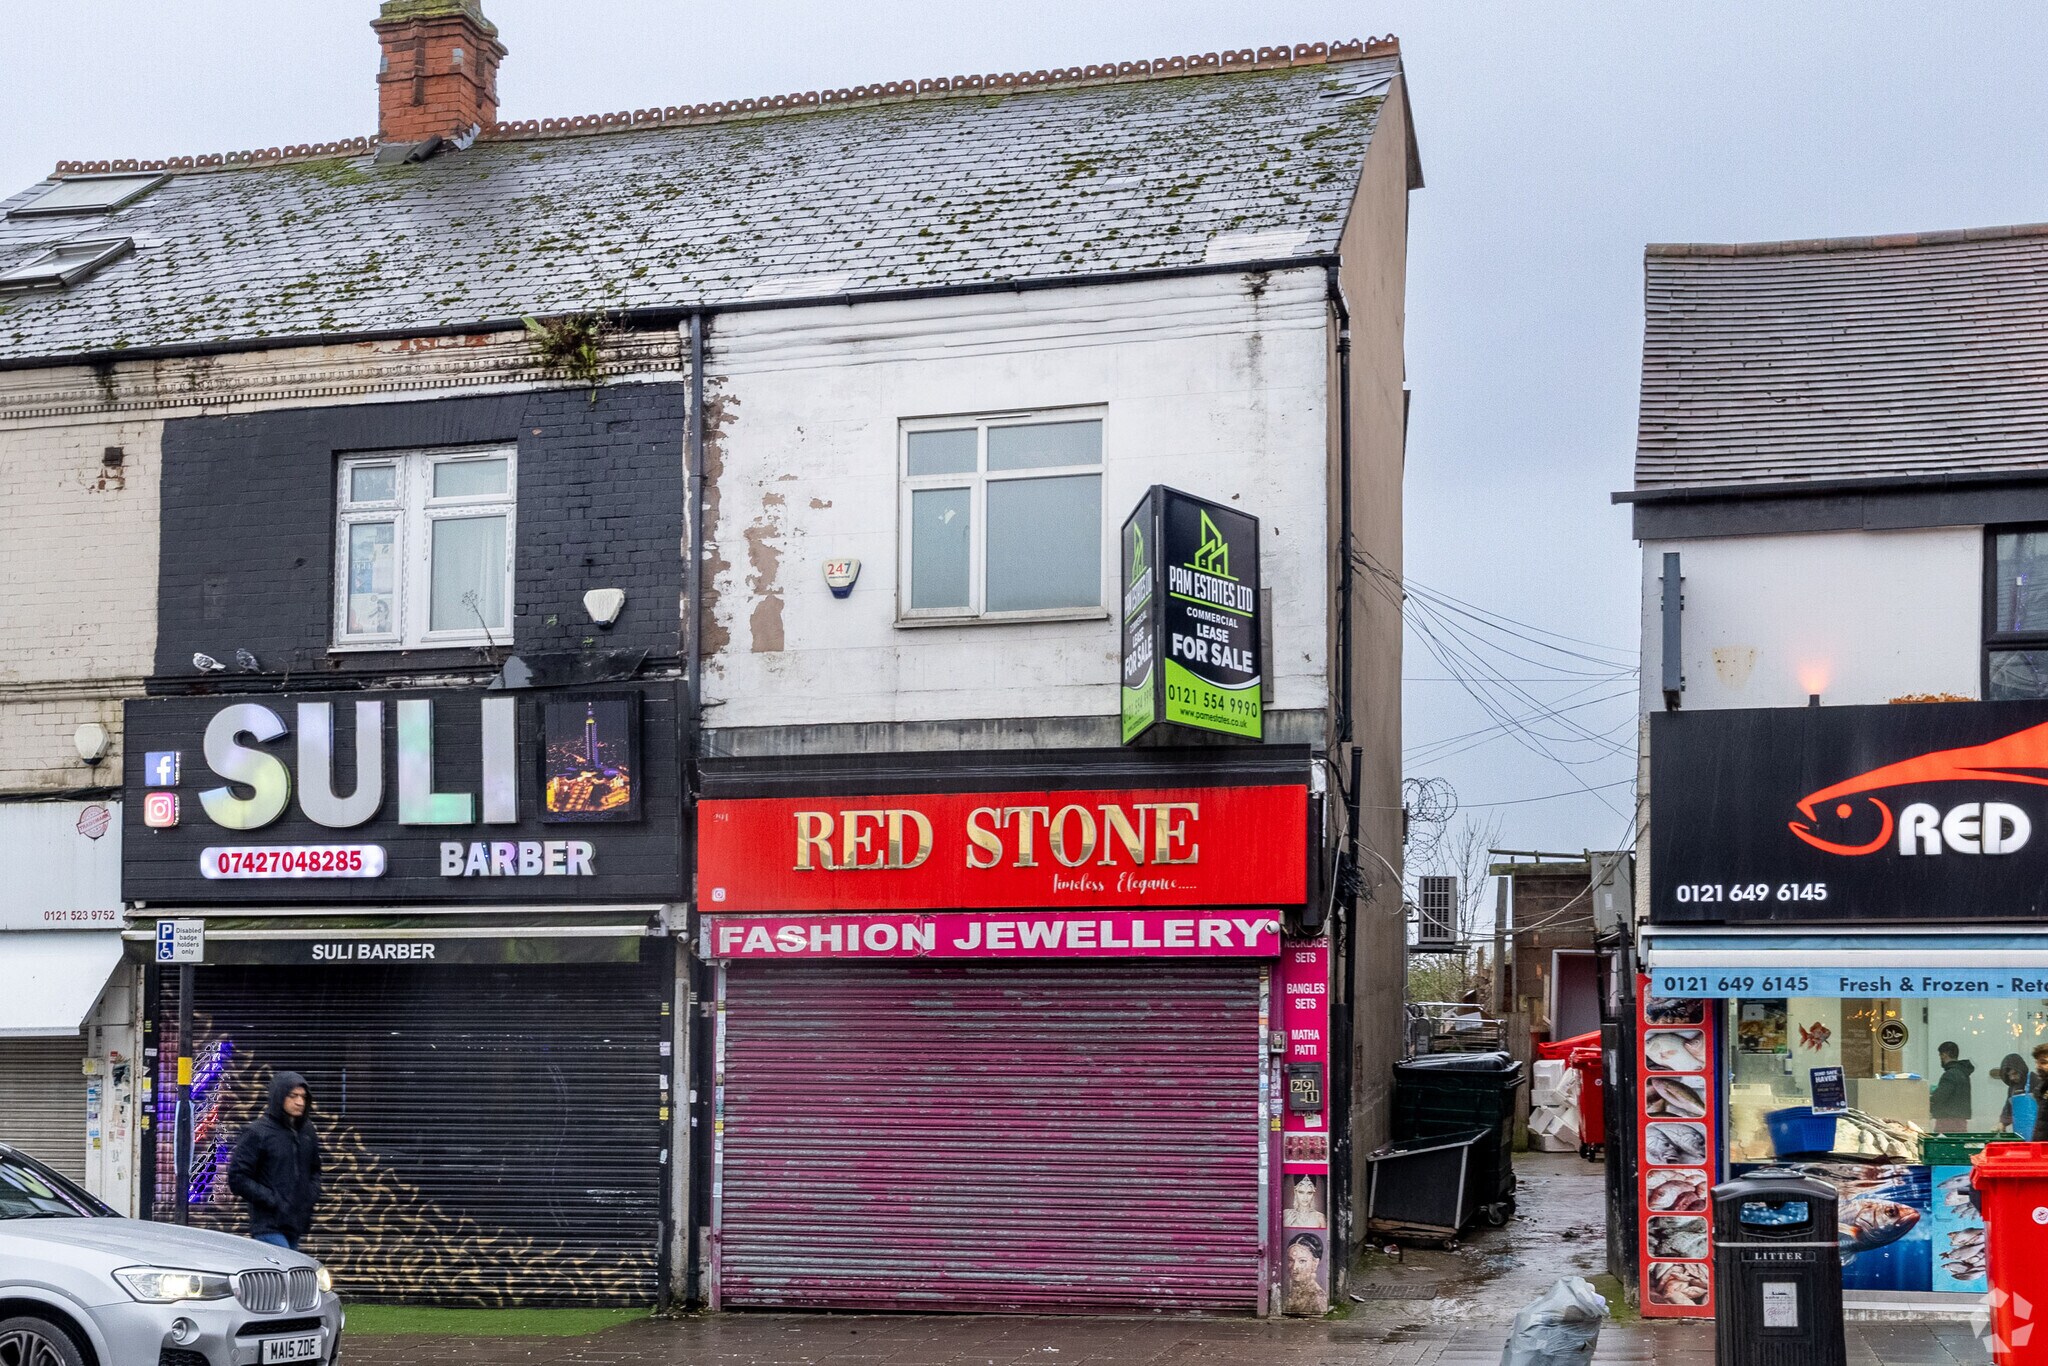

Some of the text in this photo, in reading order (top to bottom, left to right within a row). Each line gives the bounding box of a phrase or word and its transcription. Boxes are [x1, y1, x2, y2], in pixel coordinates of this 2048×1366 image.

[827, 561, 852, 575] 247
[1169, 565, 1193, 596] PAM
[1194, 573, 1235, 608] ESTATES
[1237, 585, 1253, 612] LTD
[1186, 606, 1239, 628] COMMERCIAL
[1197, 623, 1229, 643] LEASE
[1124, 652, 1138, 680] FOR
[1137, 634, 1153, 668] SALE
[1172, 633, 1253, 673] FOR SALE
[1168, 684, 1197, 705] 0121
[1203, 692, 1225, 711] 554
[1230, 698, 1257, 718] 9990
[1180, 707, 1247, 728] www.pamestates.co.uk
[198, 697, 520, 830] SULI
[793, 803, 1199, 870] RED STONE
[1898, 802, 2032, 855] RED
[218, 851, 362, 873] 07427048285
[440, 841, 597, 876] BARBER
[1676, 883, 1828, 902] 0121 649 6145
[44, 910, 115, 921] 0121 523 9752
[719, 918, 1270, 953] FASHION JEWELLERY
[312, 943, 435, 960] SULI BARBER
[1295, 952, 1317, 963] SETS
[1286, 983, 1326, 994] BANGLES
[1664, 977, 1707, 992] 0121
[1717, 977, 1754, 992] 649
[1761, 977, 1809, 992] 6145
[1840, 976, 1892, 992] Fresh
[1900, 977, 1914, 991] &
[1922, 976, 1989, 992] Frozen
[1295, 998, 1317, 1009] SETS
[1291, 1029, 1320, 1040] MATHA
[1294, 1045, 1317, 1055] PATTI
[1293, 1081, 1312, 1091] 29
[1814, 1075, 1838, 1083] HAVEN
[1755, 1252, 1802, 1260] LITTER
[270, 1338, 315, 1360] MA15 ZDE
